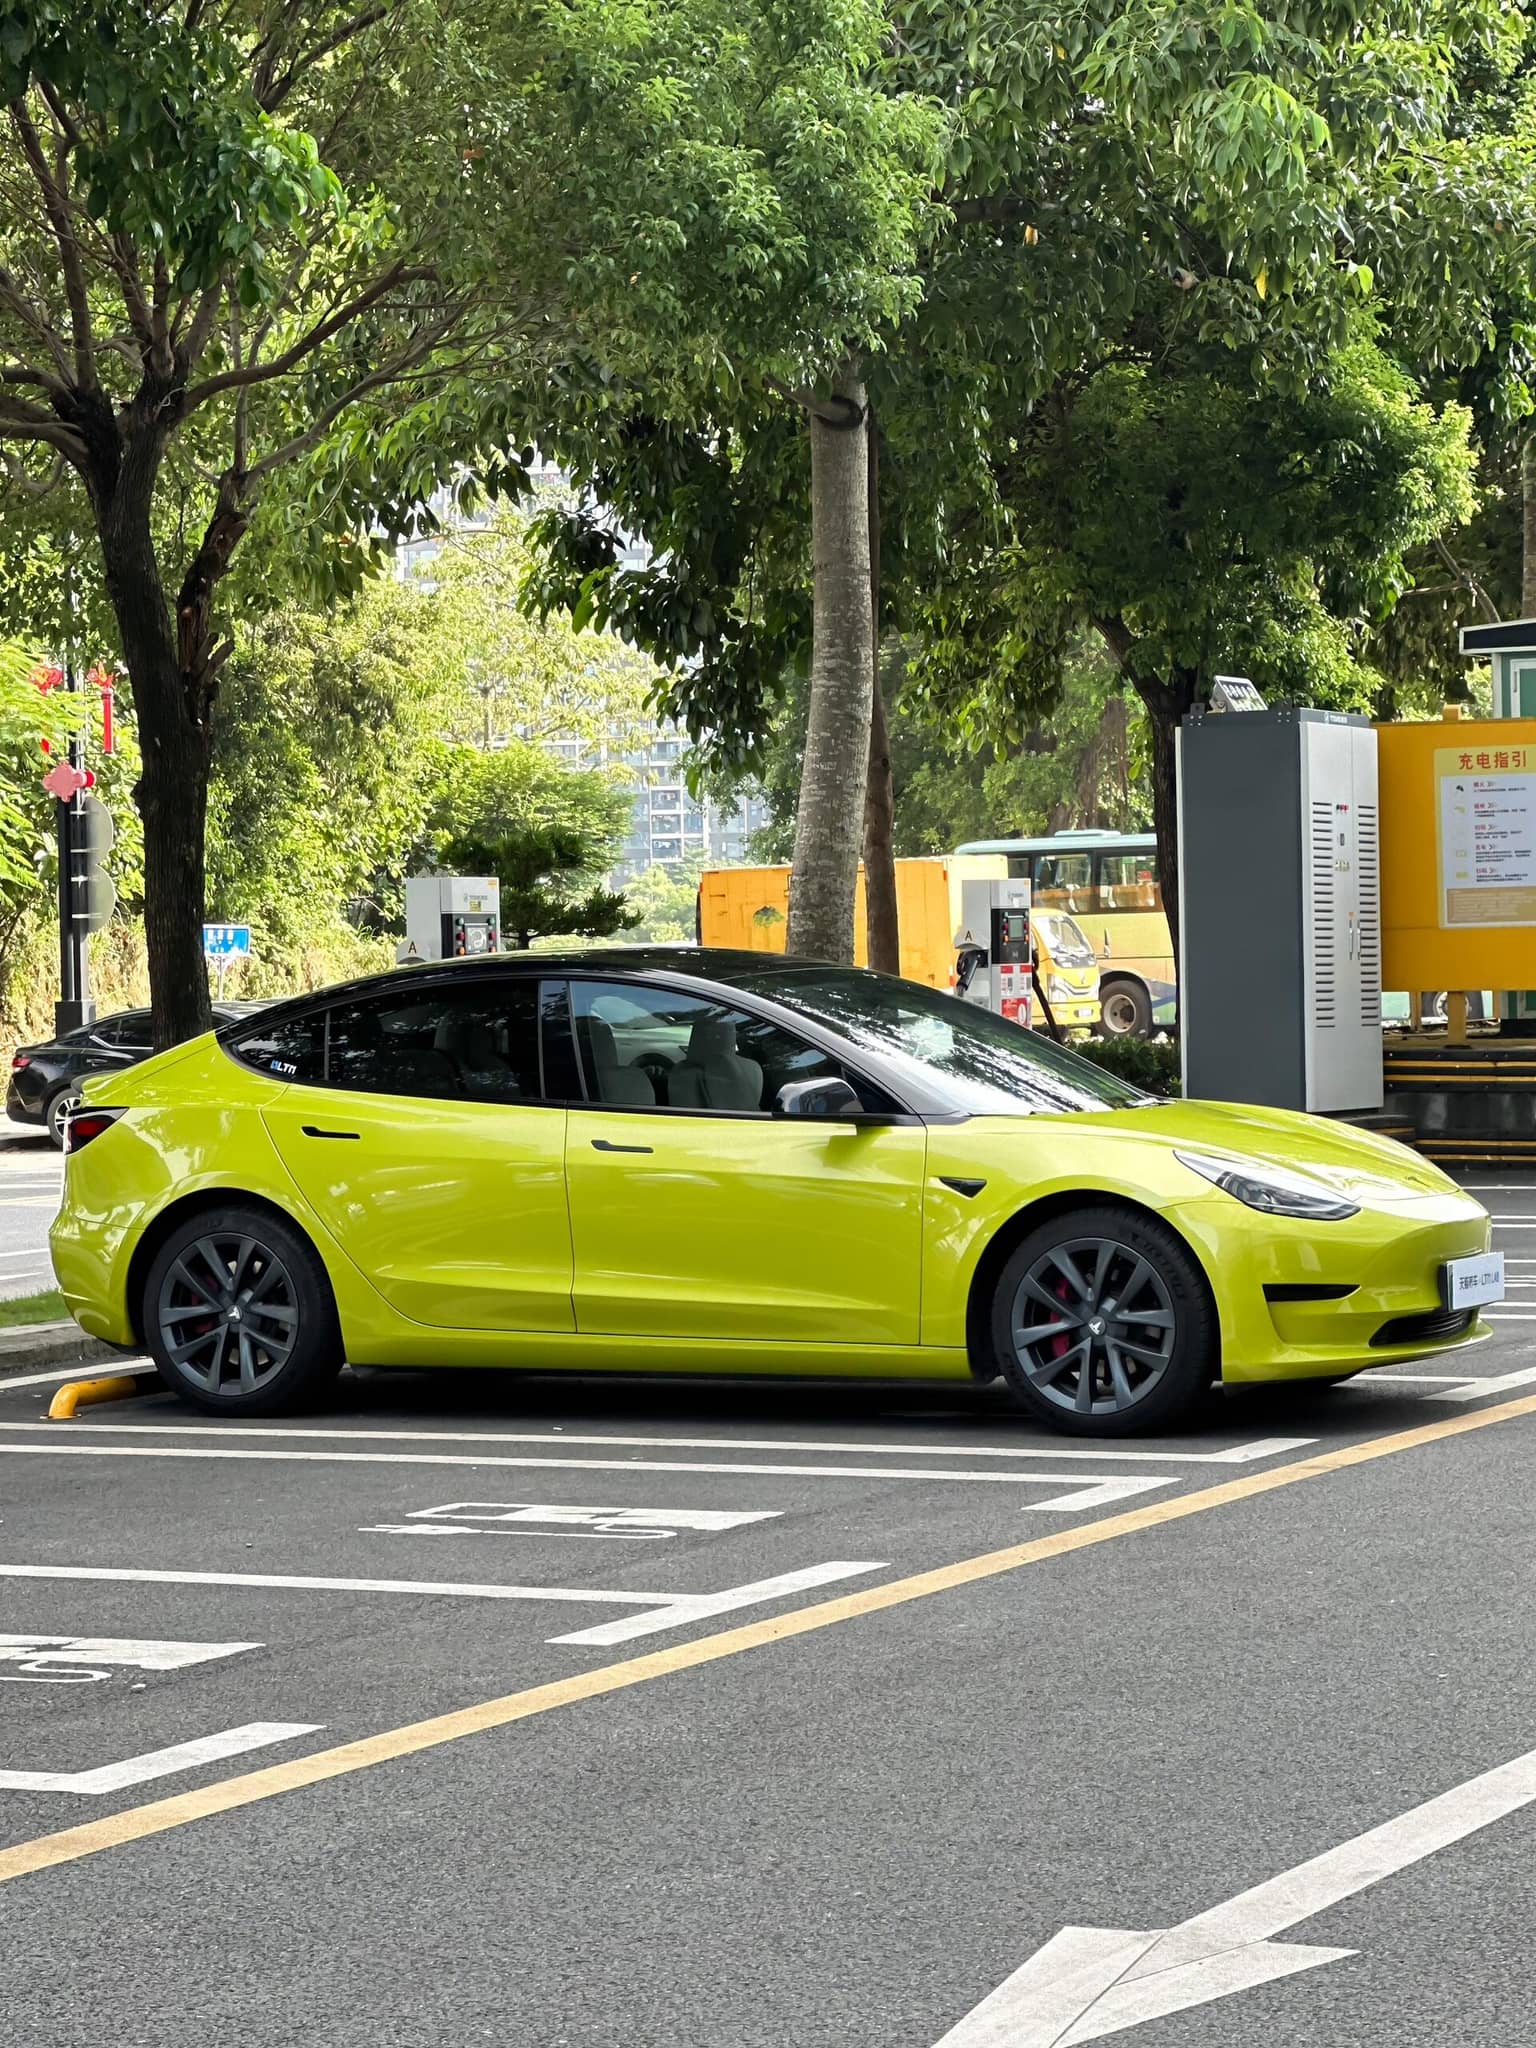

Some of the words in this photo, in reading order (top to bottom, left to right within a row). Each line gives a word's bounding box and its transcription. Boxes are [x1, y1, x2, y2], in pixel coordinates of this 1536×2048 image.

[1458, 751, 1527, 770] 充电指引
[964, 931, 973, 941] A
[408, 941, 417, 953] A
